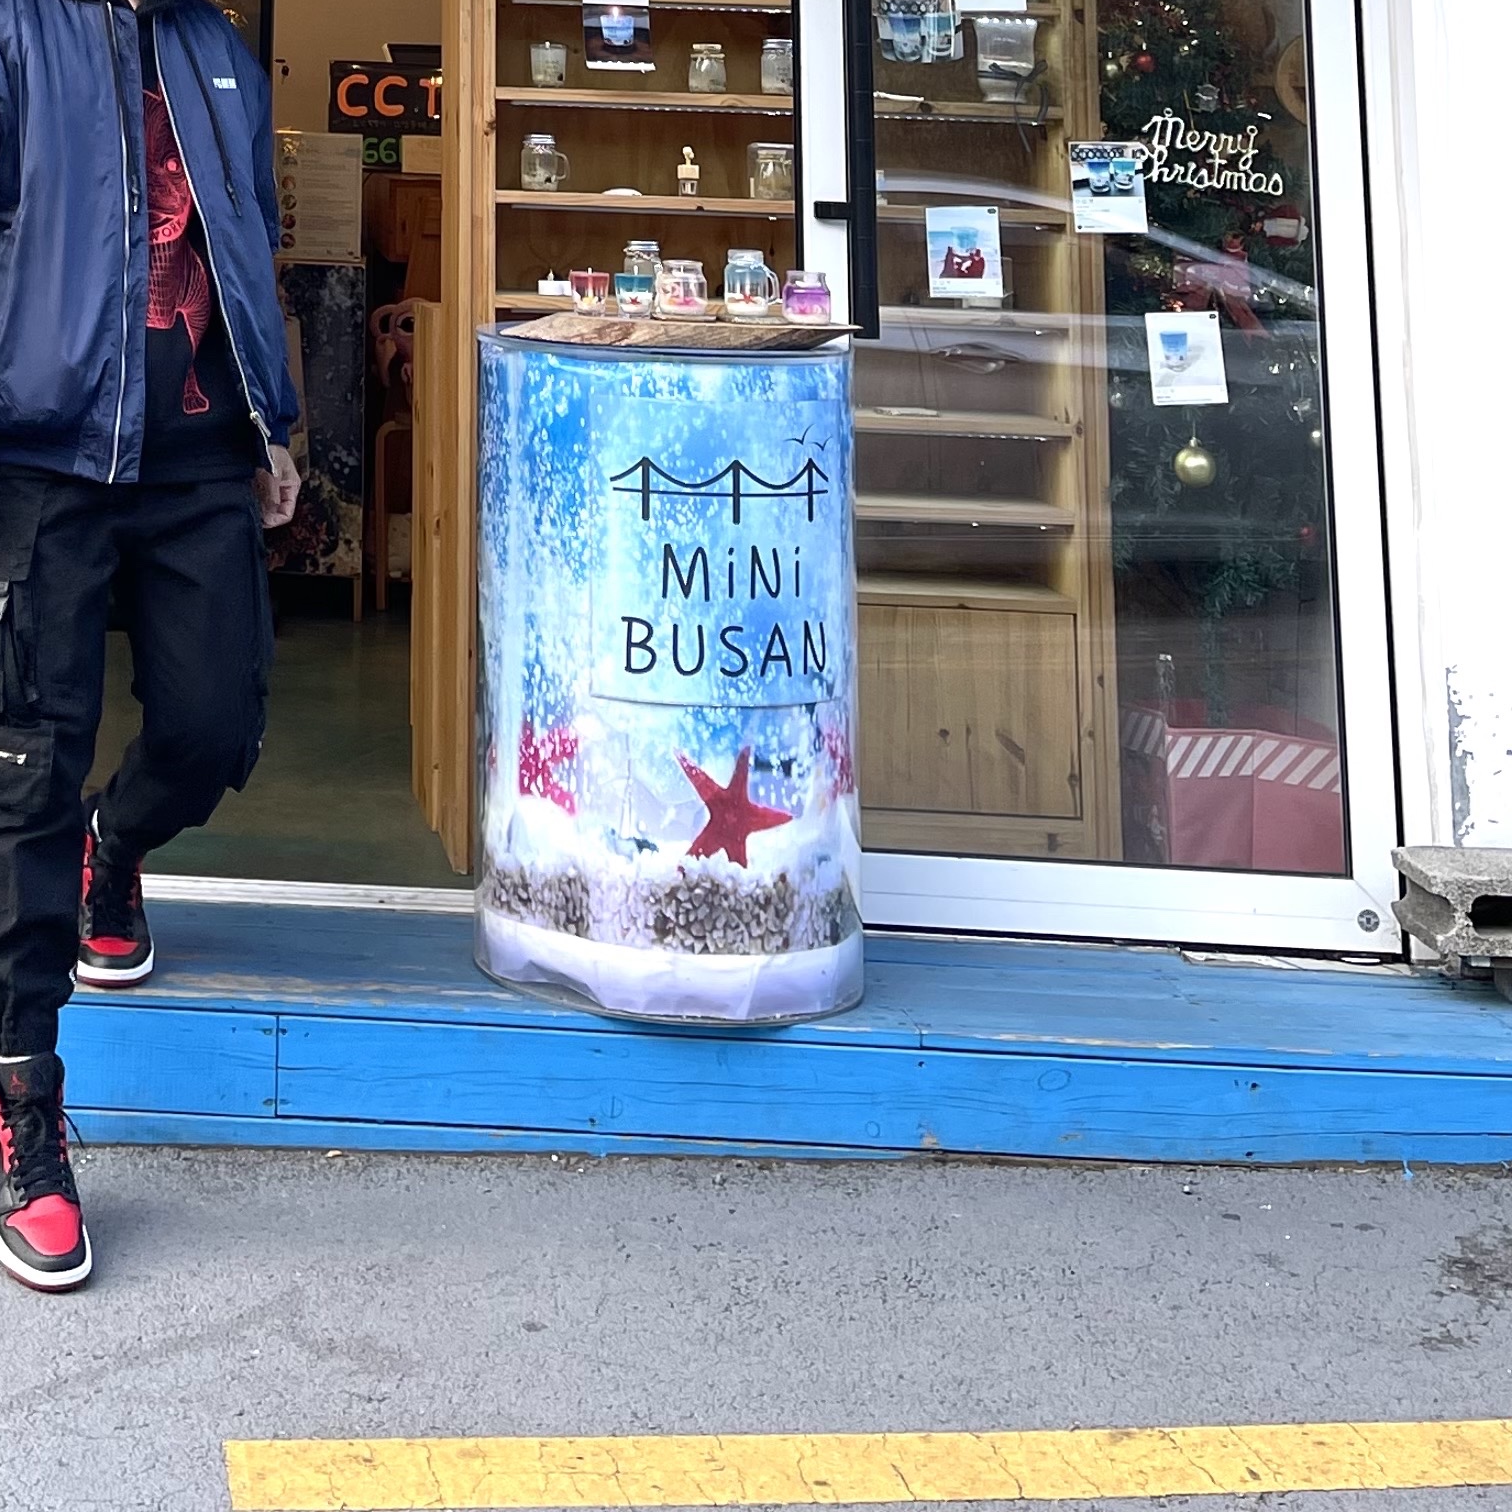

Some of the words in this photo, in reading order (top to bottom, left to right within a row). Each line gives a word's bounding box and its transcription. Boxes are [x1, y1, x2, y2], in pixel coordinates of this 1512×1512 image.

[1133, 142, 1284, 196] Christmas
[1142, 113, 1260, 171] Merry
[661, 542, 800, 603] MiNi
[620, 615, 827, 678] BUSAN
